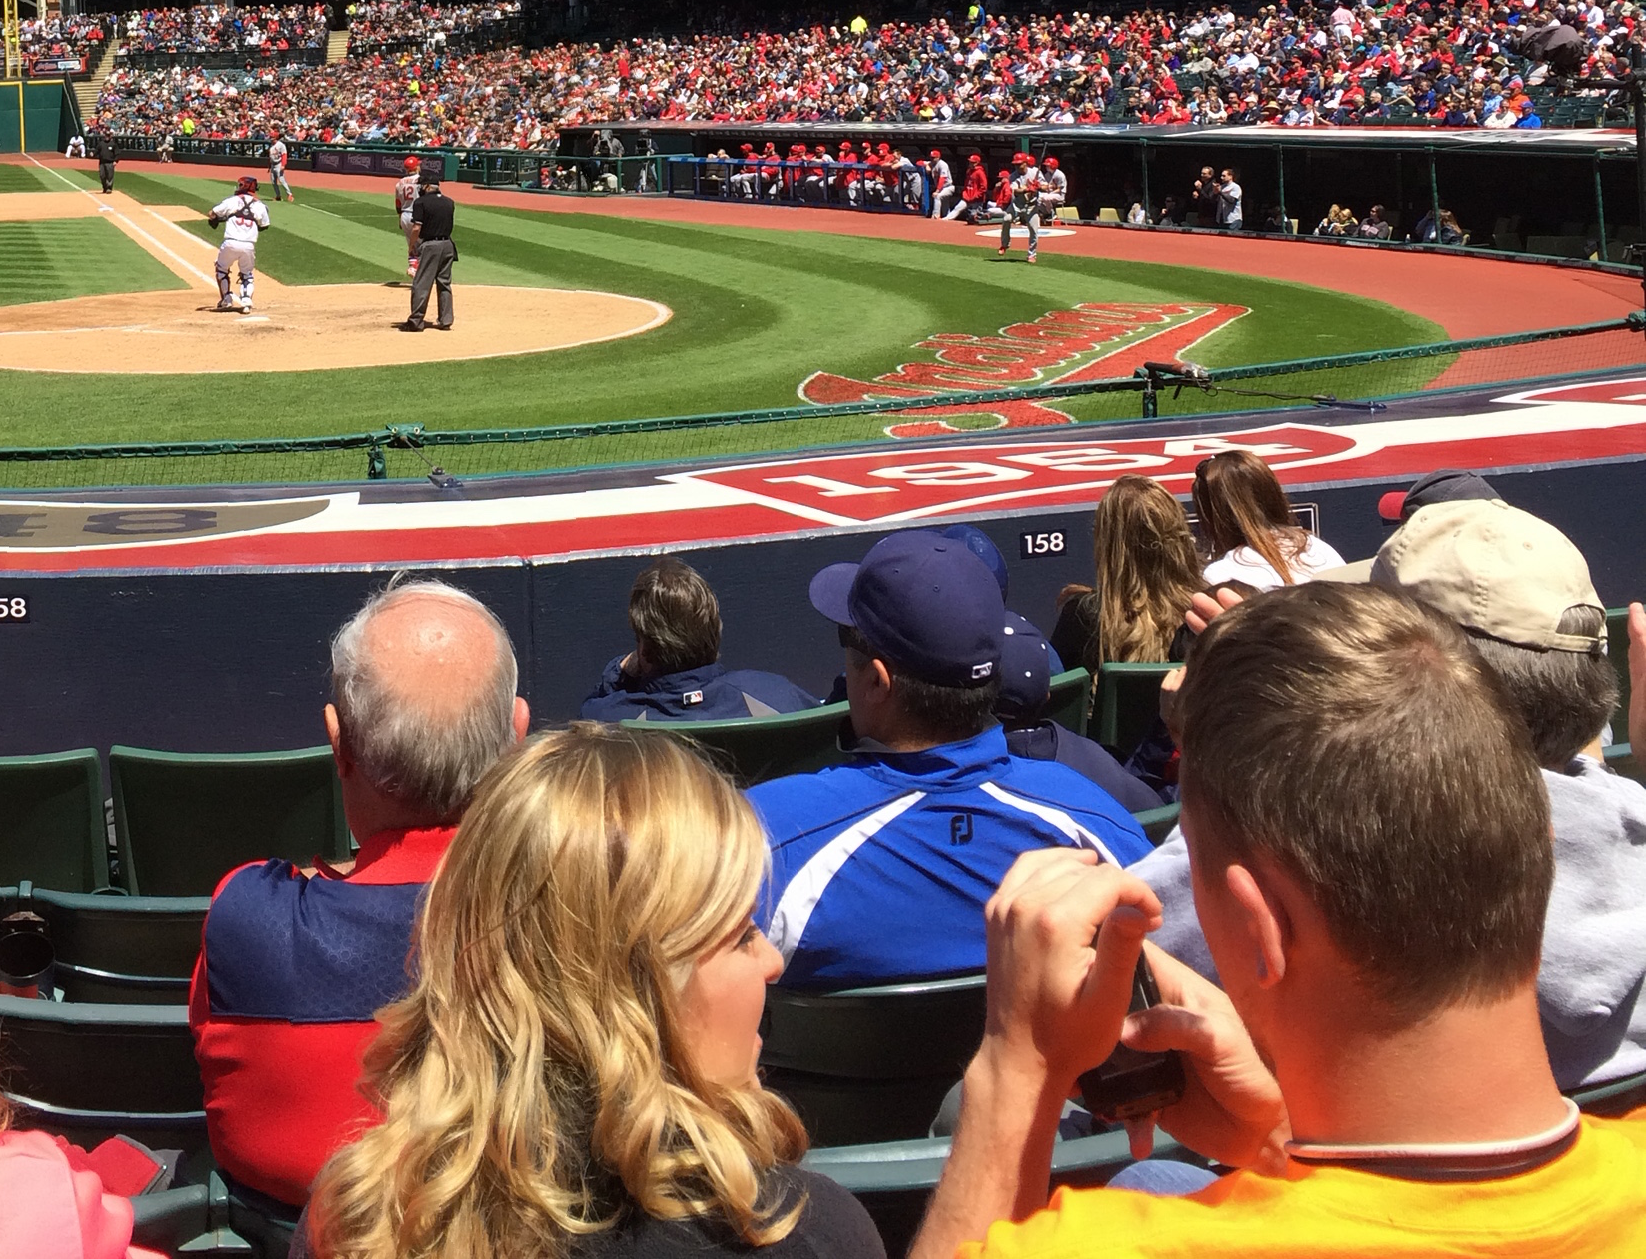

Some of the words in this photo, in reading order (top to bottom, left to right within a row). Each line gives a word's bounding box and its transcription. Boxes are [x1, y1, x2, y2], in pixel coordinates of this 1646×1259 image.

[402, 186, 414, 201] 12
[761, 435, 1309, 499] 1954
[1023, 529, 1065, 555] 158
